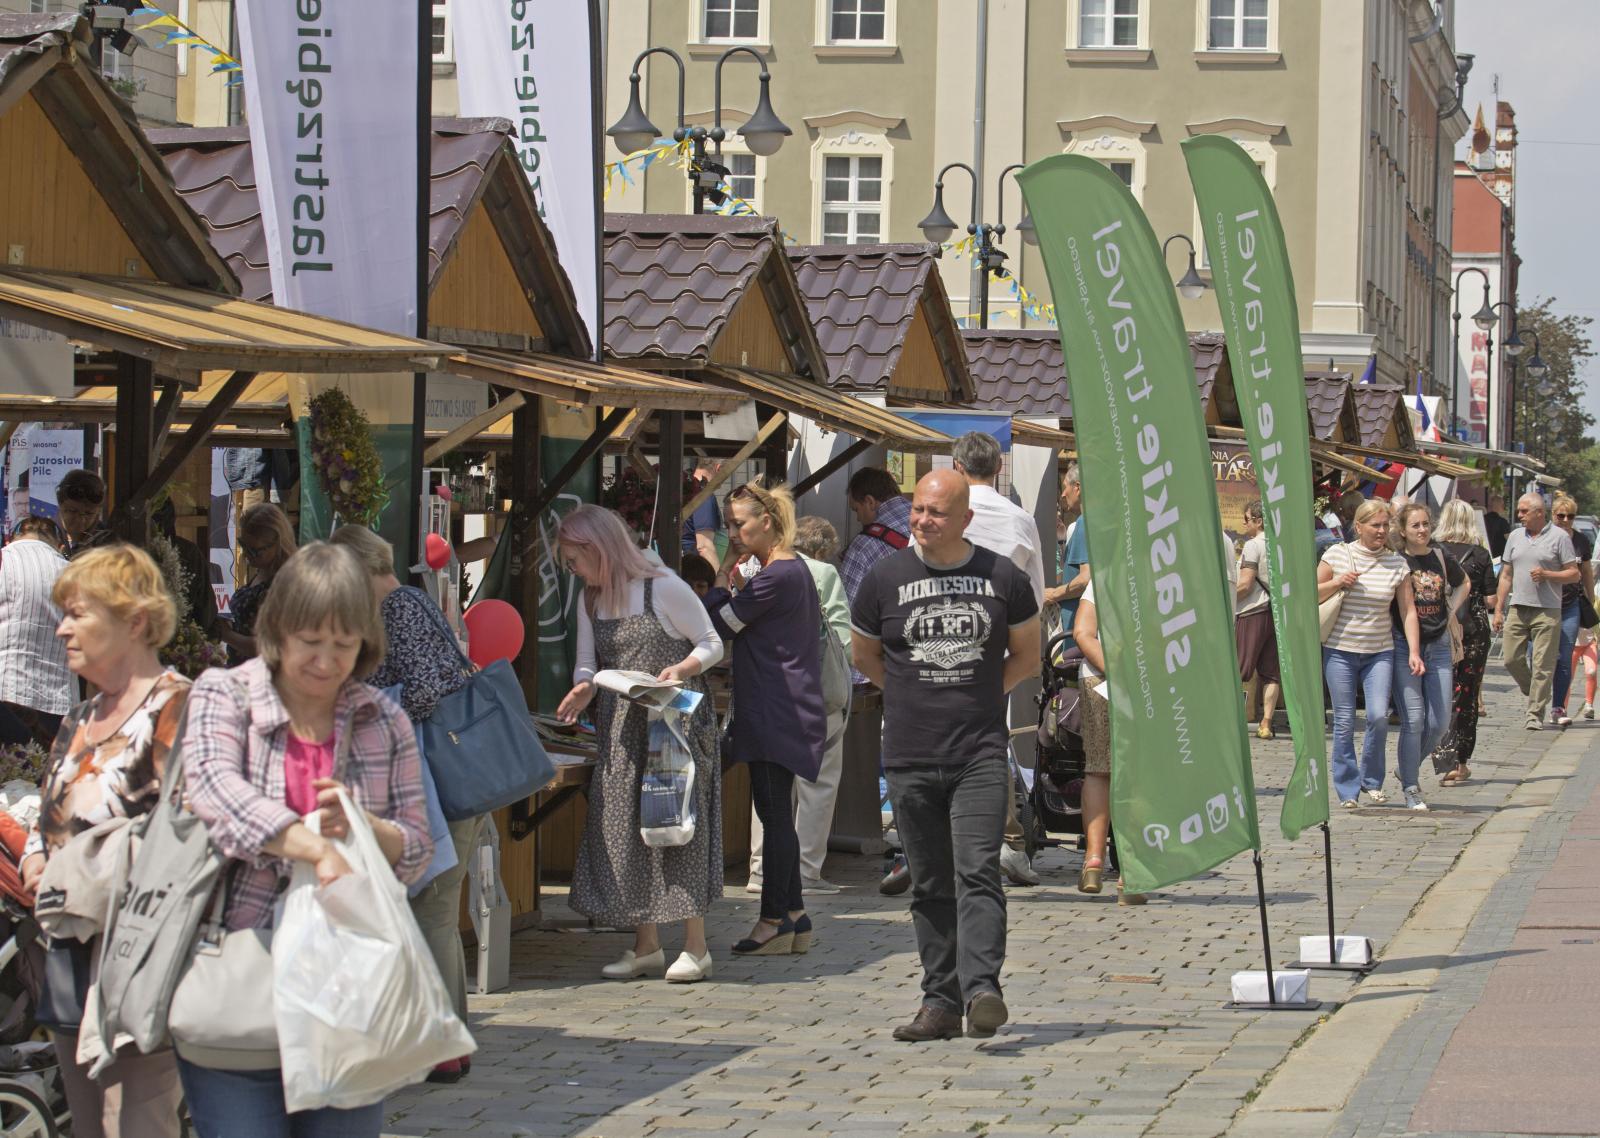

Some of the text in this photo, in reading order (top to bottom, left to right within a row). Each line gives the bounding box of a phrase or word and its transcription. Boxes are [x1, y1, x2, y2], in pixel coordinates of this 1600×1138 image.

[32, 456, 82, 465] Jarosław
[32, 466, 52, 476] Pilc
[898, 576, 996, 606] MINNESOTA
